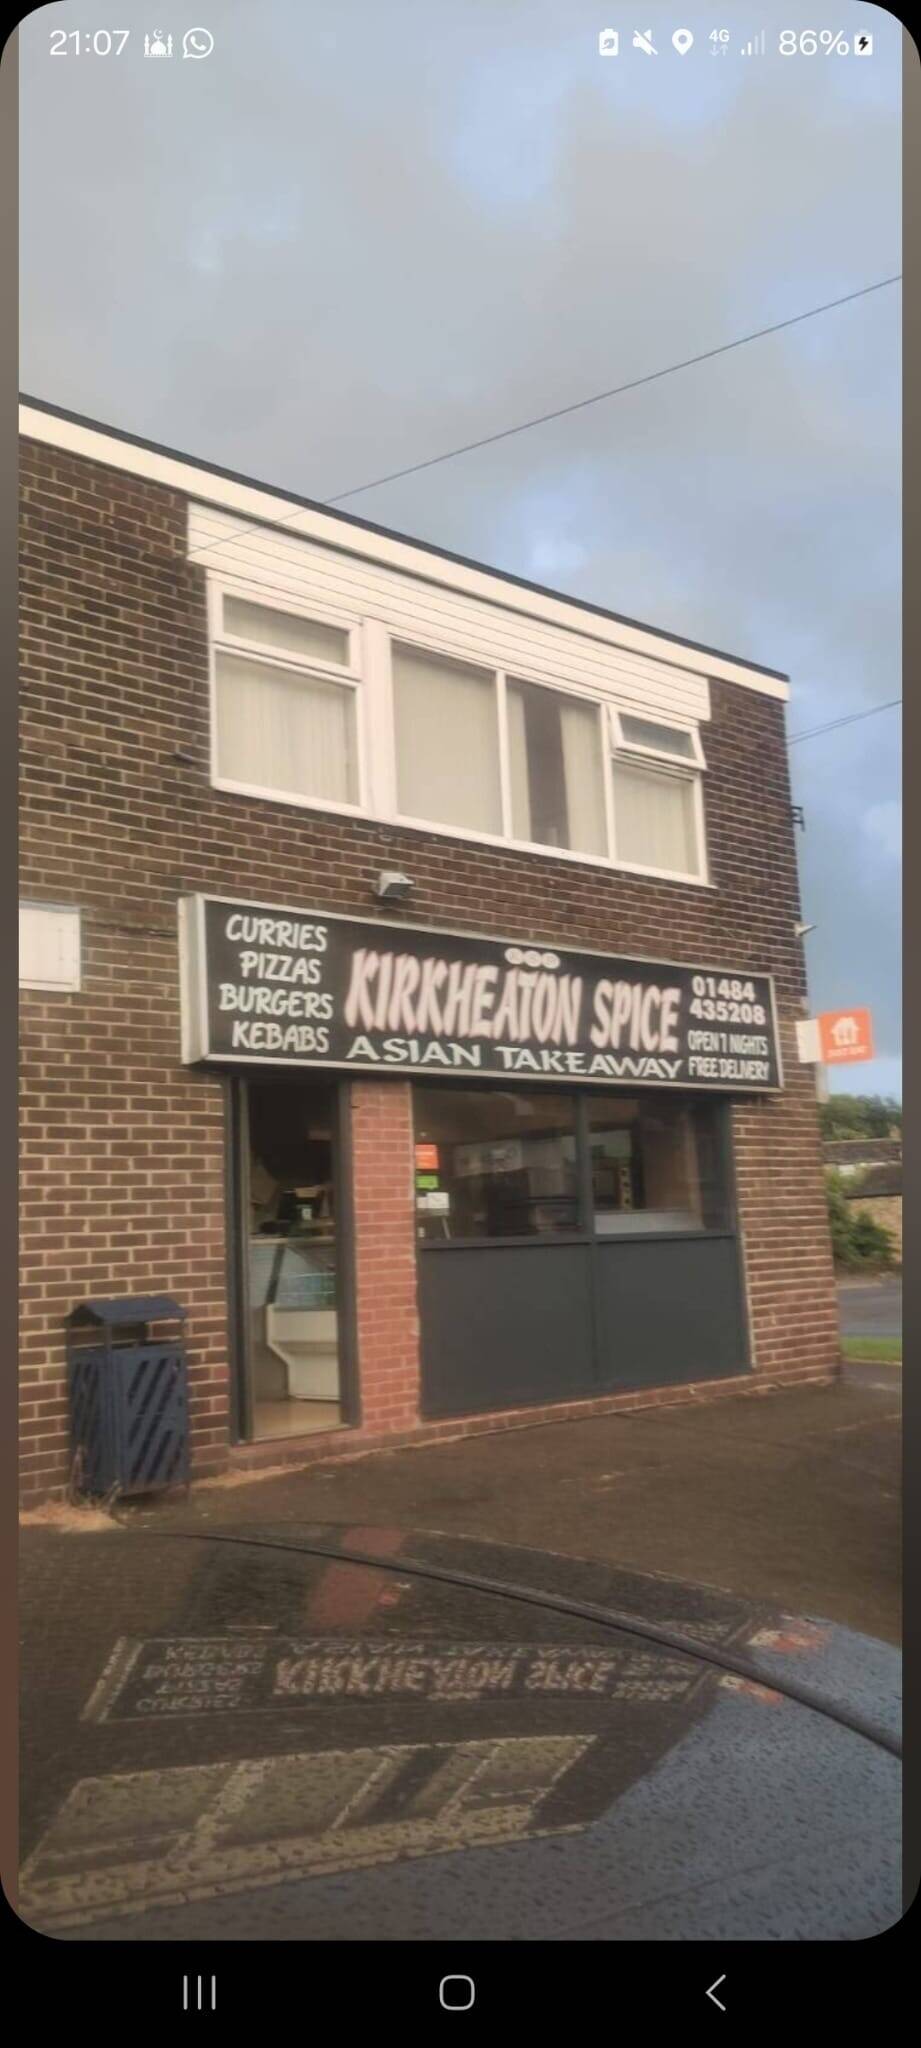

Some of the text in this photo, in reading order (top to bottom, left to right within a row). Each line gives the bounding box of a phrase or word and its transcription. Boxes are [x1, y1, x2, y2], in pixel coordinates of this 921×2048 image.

[226, 913, 328, 952] CURRIES
[239, 950, 322, 985] PIZZAS
[218, 983, 334, 1020] BURGERS
[344, 947, 681, 1053] KIRKHEATON SPICE
[692, 975, 756, 1003] 01484
[689, 998, 766, 1025] 435208
[232, 1020, 330, 1054] KEBABS
[687, 1029, 720, 1052] OPEN
[345, 1035, 683, 1080] ASIAN TAKEAWAY
[688, 1056, 719, 1078] FREE
